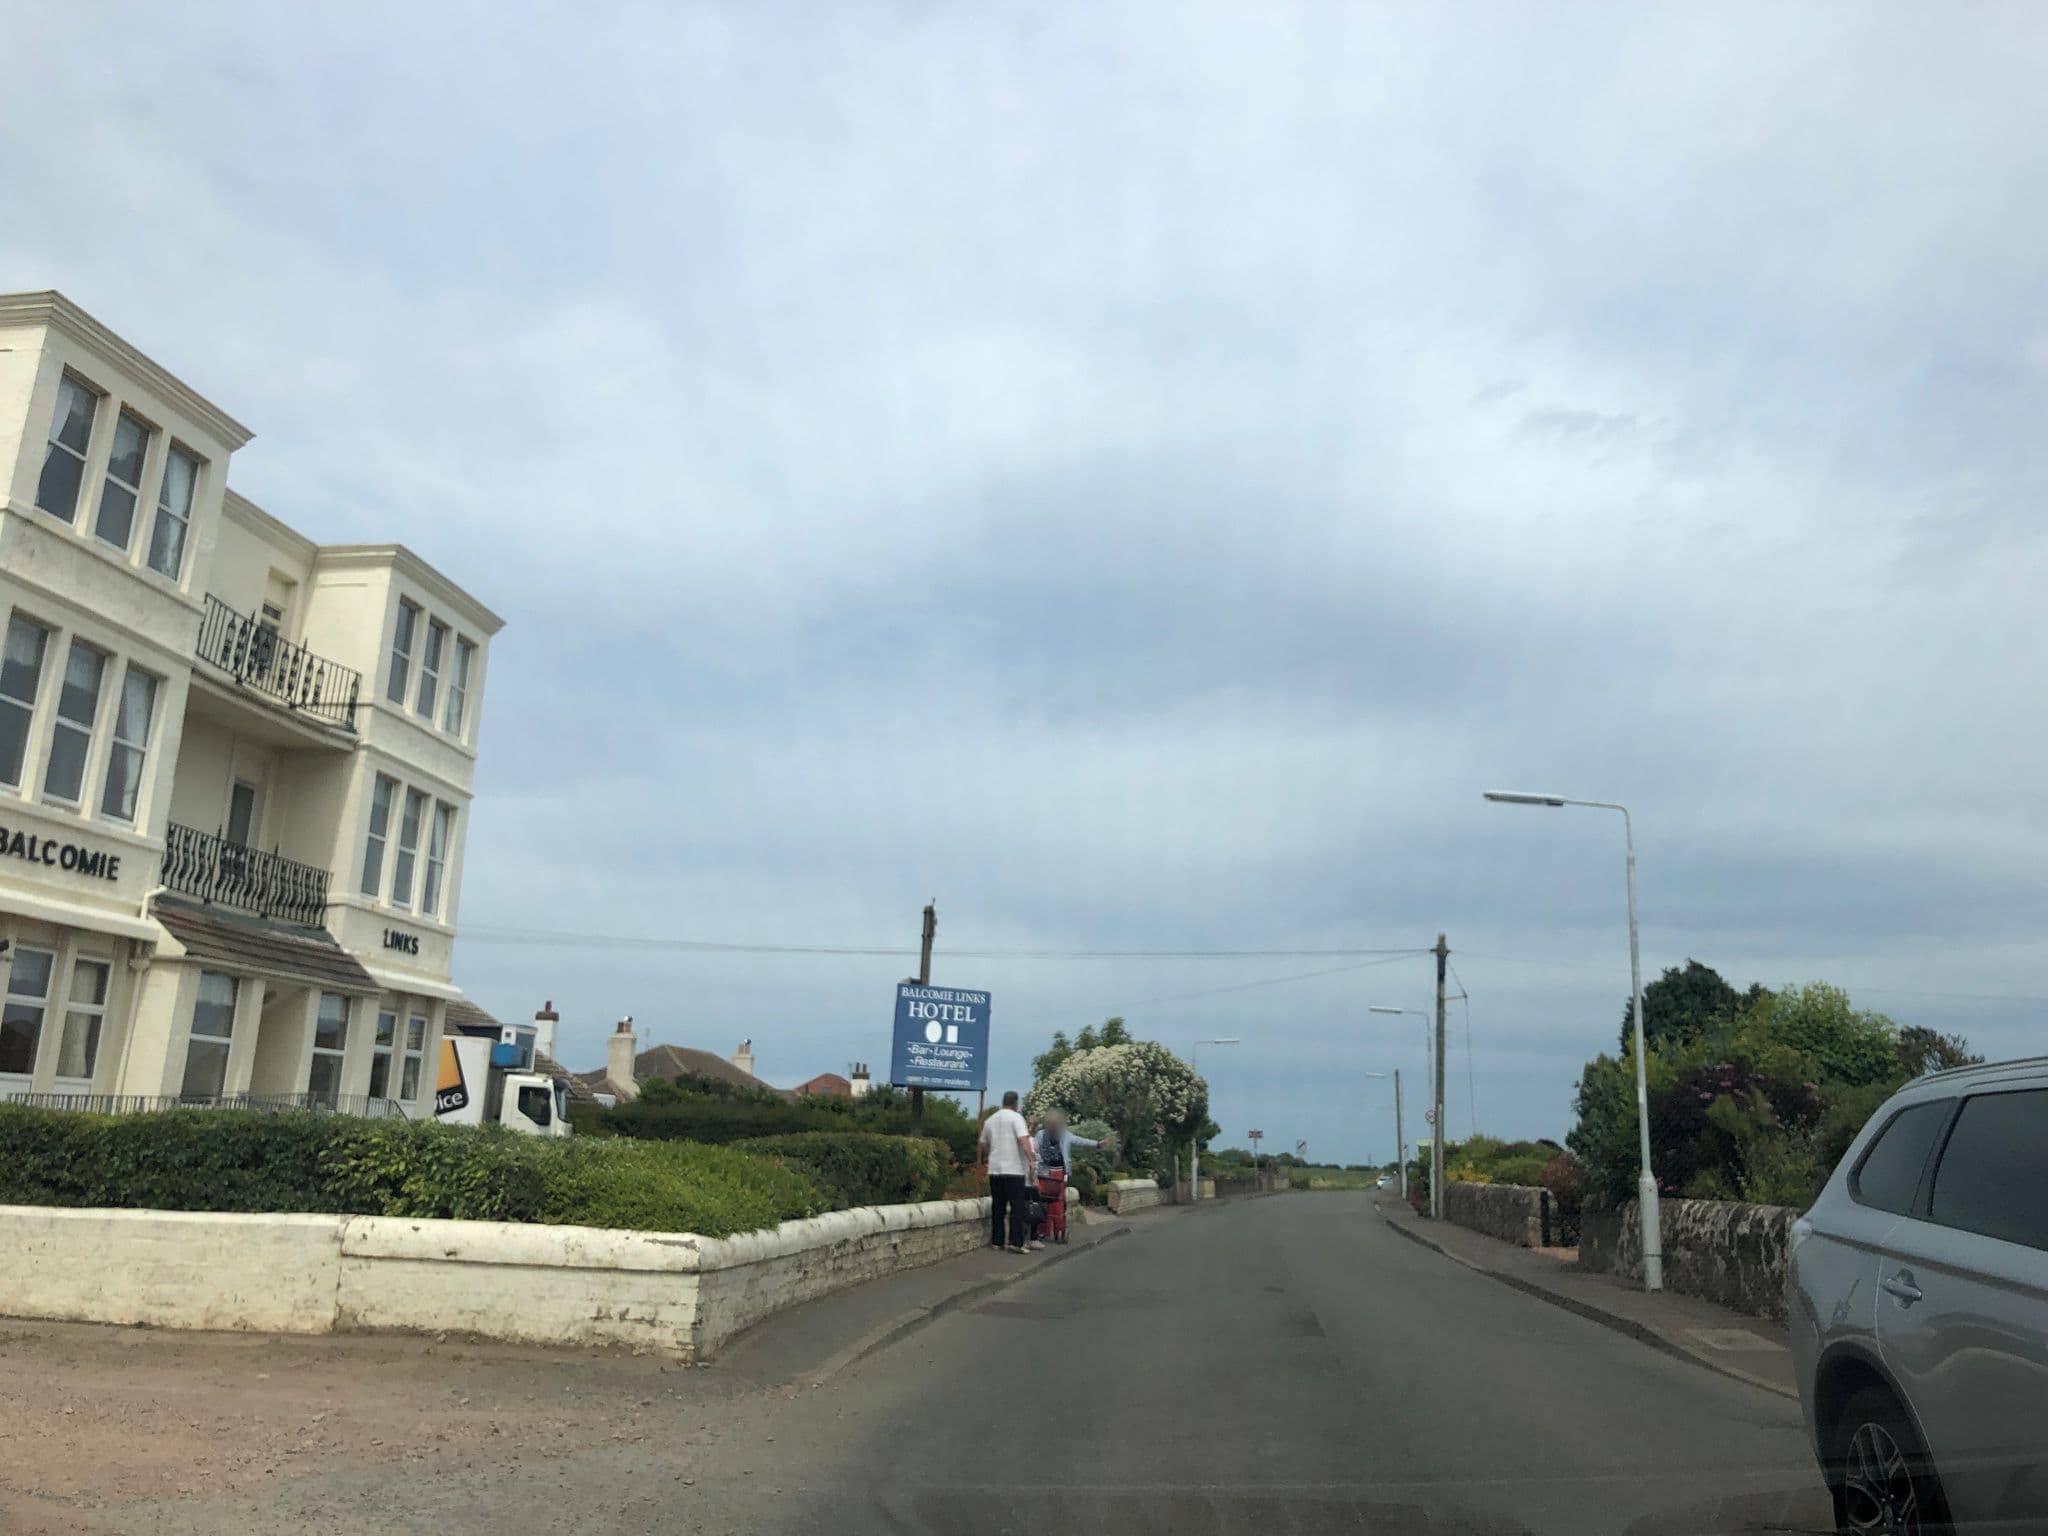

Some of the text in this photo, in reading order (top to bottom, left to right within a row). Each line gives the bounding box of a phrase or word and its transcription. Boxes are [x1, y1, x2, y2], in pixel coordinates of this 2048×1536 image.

[0, 826, 120, 882] BALCOMIE
[383, 928, 419, 955] LINKS
[901, 986, 986, 1004] BALCOMIE LINKS
[908, 1001, 977, 1022] HOTEL
[911, 1044, 969, 1060] Bar Lounge
[914, 1055, 966, 1069] Restaurant
[435, 1092, 463, 1110] ice
